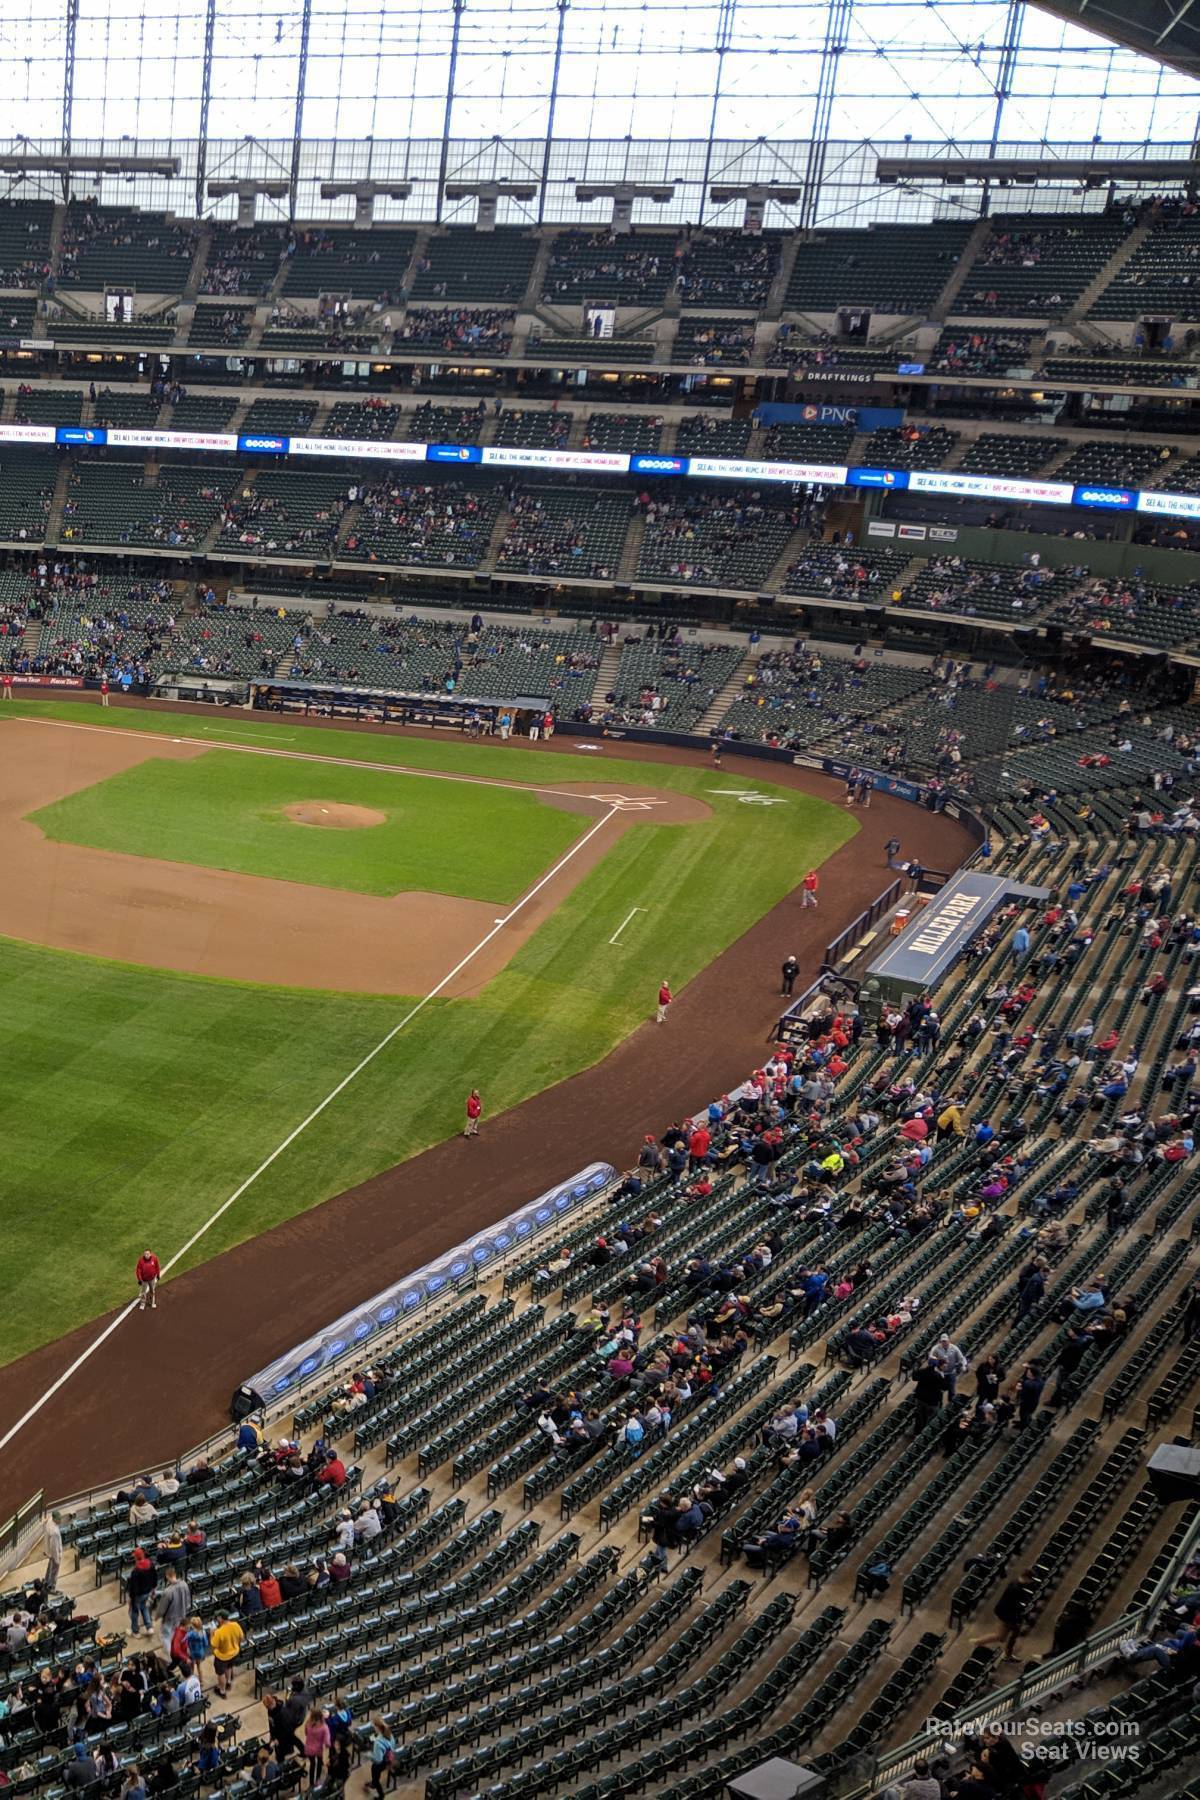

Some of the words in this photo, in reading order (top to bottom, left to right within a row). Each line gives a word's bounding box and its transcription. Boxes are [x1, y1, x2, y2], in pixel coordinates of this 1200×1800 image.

[807, 372, 872, 383] DRAFTKINGS
[821, 407, 857, 422] PNC
[50, 677, 66, 685] KWIK
[908, 916, 961, 955] MILLER
[940, 893, 981, 919] PARK
